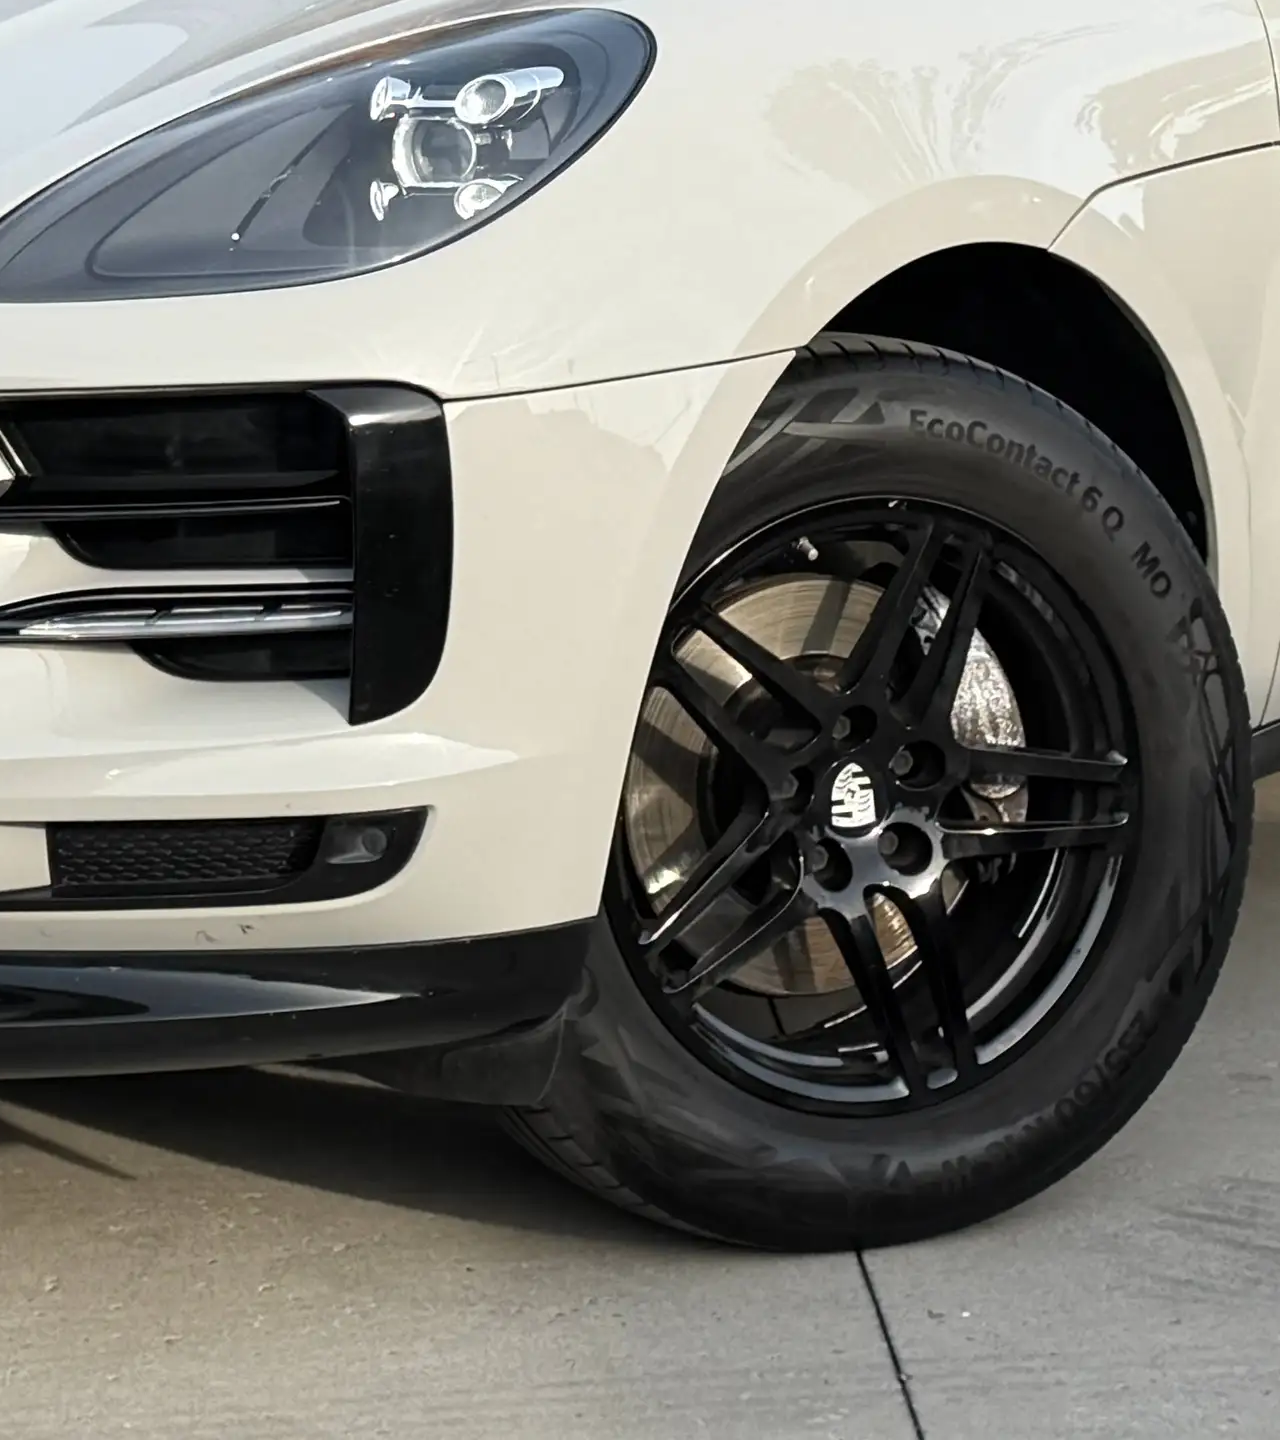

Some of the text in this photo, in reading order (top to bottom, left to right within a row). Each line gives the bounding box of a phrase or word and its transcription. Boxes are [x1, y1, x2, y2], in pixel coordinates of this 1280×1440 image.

[908, 408, 1081, 496] EcoContact
[1079, 484, 1104, 514] 6
[1130, 540, 1173, 599] MO
